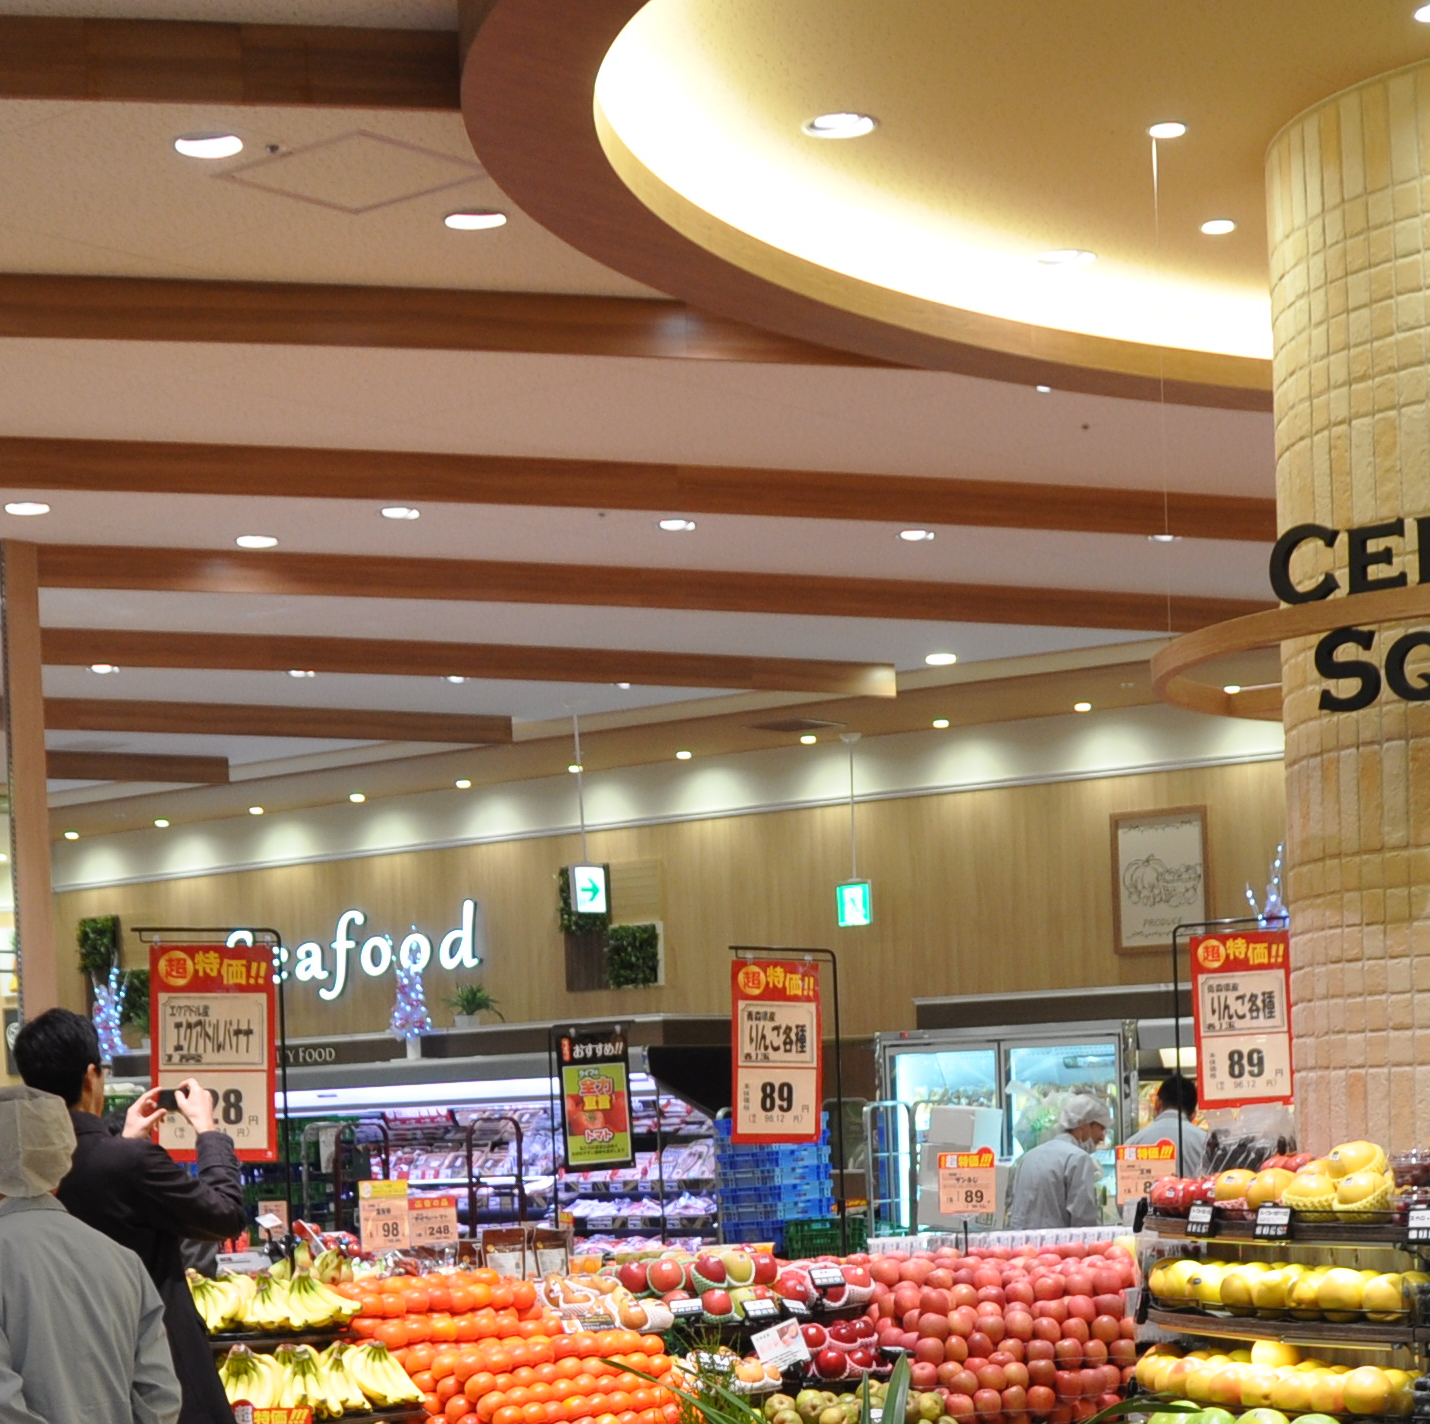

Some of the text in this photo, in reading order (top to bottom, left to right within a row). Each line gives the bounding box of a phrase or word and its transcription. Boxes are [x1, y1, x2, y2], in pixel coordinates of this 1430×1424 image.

[1142, 916, 1183, 927] PRODUCE
[226, 899, 479, 1000] afood
[169, 1005, 210, 1018] エクアドル産
[1210, 991, 1276, 1021] りんご各種
[174, 1019, 253, 1054] エクアドルバナナ
[749, 1024, 807, 1054] りんご各種
[299, 1046, 336, 1063] FOOD
[573, 1042, 623, 1058] おすすめ!!
[1228, 1048, 1265, 1078] 89
[760, 1082, 793, 1113] 89
[584, 1128, 613, 1144] トマト
[965, 1189, 984, 1203] 89
[382, 1222, 400, 1237] 98
[428, 1225, 450, 1236] 248
